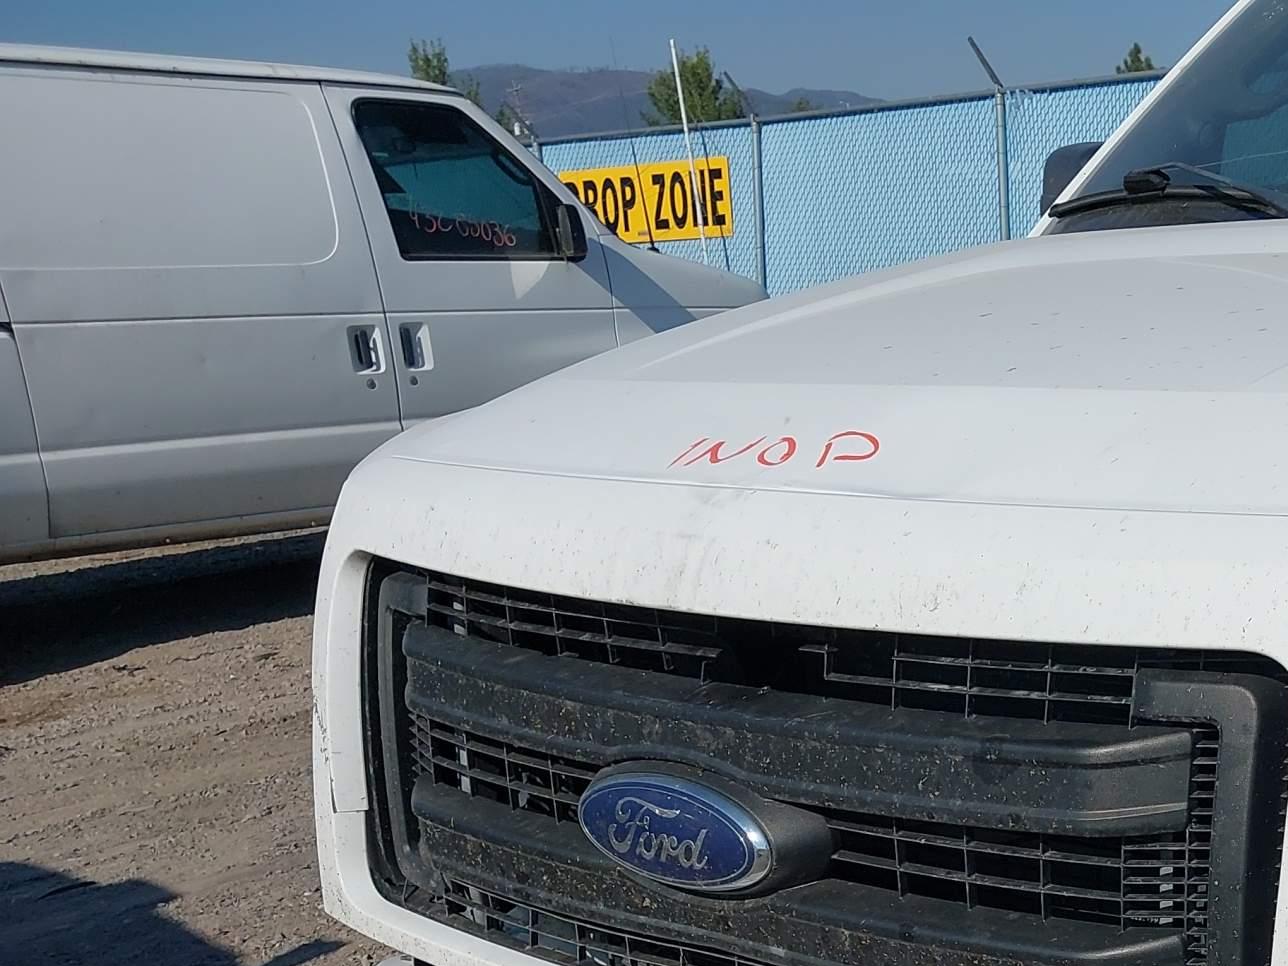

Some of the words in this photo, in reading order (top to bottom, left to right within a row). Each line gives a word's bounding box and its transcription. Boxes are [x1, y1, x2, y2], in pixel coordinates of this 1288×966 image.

[652, 168, 726, 230] ZONE
[667, 430, 880, 469] INOP
[607, 796, 710, 870] Ford
